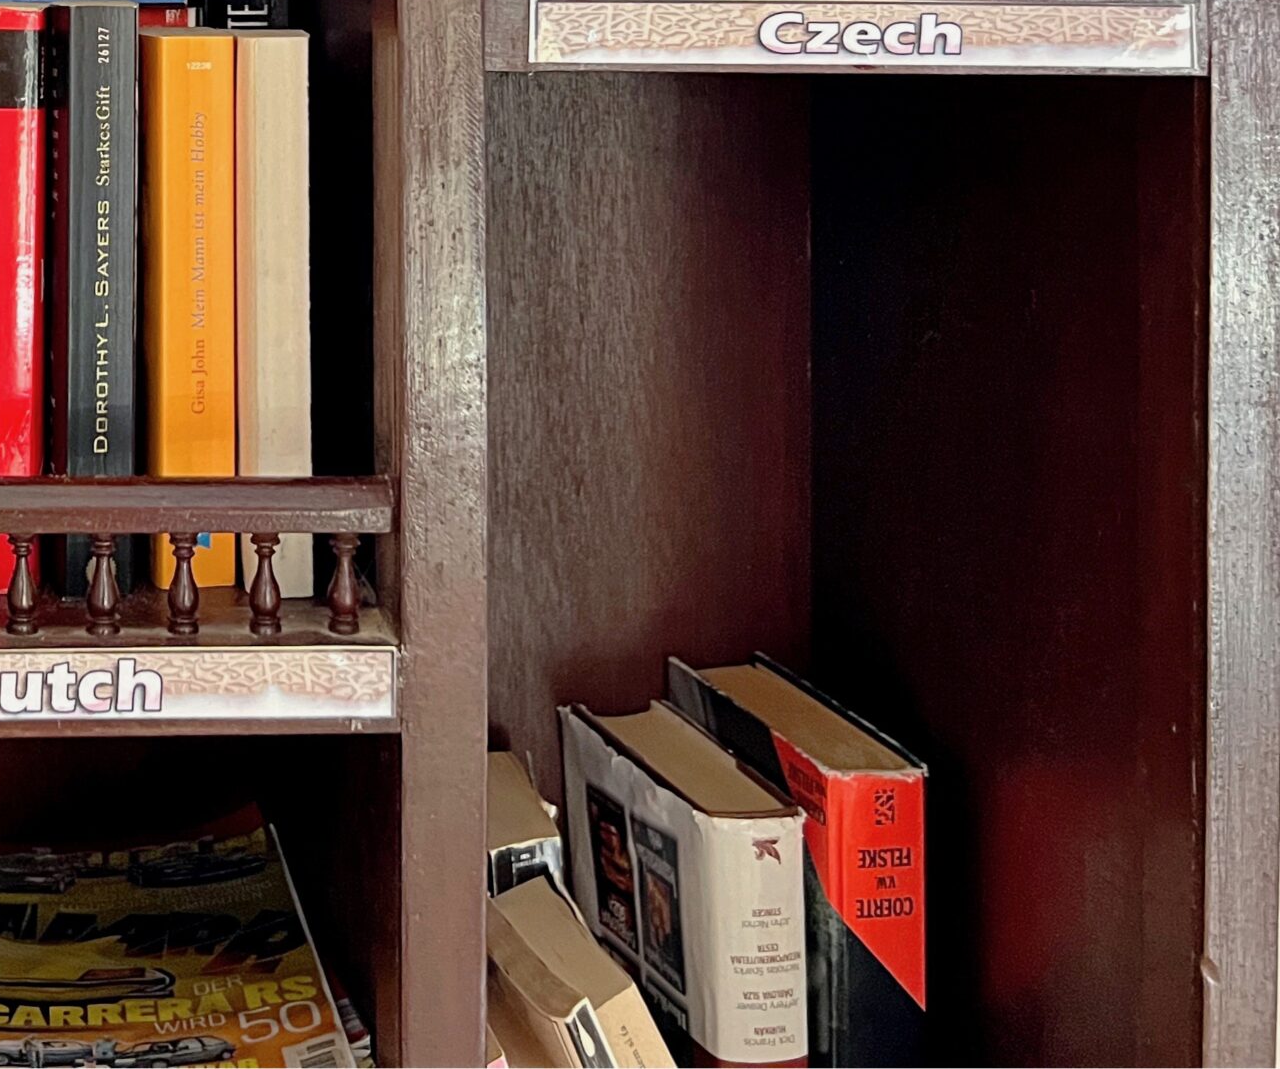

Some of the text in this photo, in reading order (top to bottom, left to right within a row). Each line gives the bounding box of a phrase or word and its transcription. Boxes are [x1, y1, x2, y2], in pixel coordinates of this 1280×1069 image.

[758, 11, 963, 56] Czech
[94, 26, 111, 454] DOROTHY L. SAYERS Starkes Gift 26127
[190, 112, 208, 415] Gisa John Mein Mann ist mein Hobby
[857, 847, 912, 869] FELSKE
[856, 897, 914, 919] COERTE
[193, 974, 243, 997] DER
[243, 976, 317, 1009] RS
[153, 1000, 321, 1044] WIRD 50
